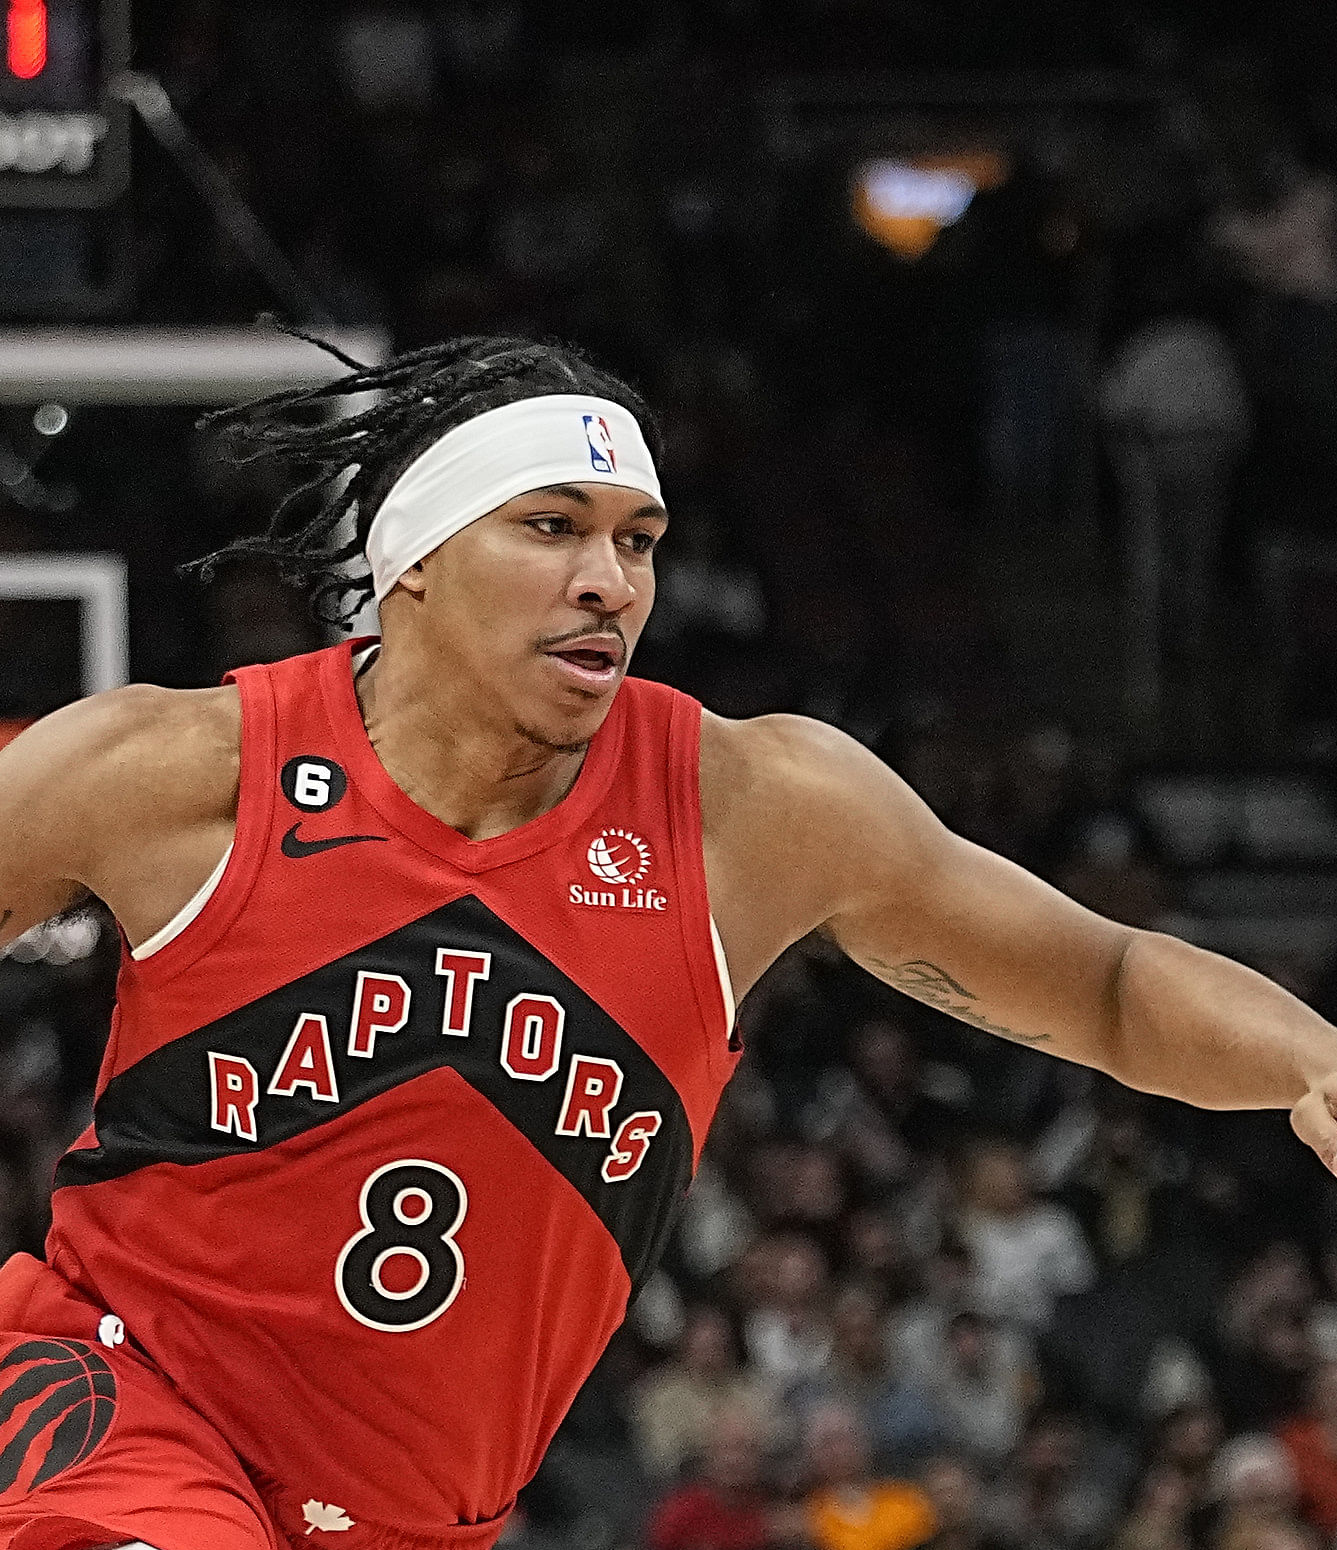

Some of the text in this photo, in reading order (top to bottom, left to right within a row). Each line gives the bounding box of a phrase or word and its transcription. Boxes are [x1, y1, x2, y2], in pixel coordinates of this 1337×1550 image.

[294, 763, 331, 806] 6
[568, 884, 668, 911] Sun Life
[207, 947, 662, 1183] RAPTORS
[335, 1158, 468, 1334] 8
